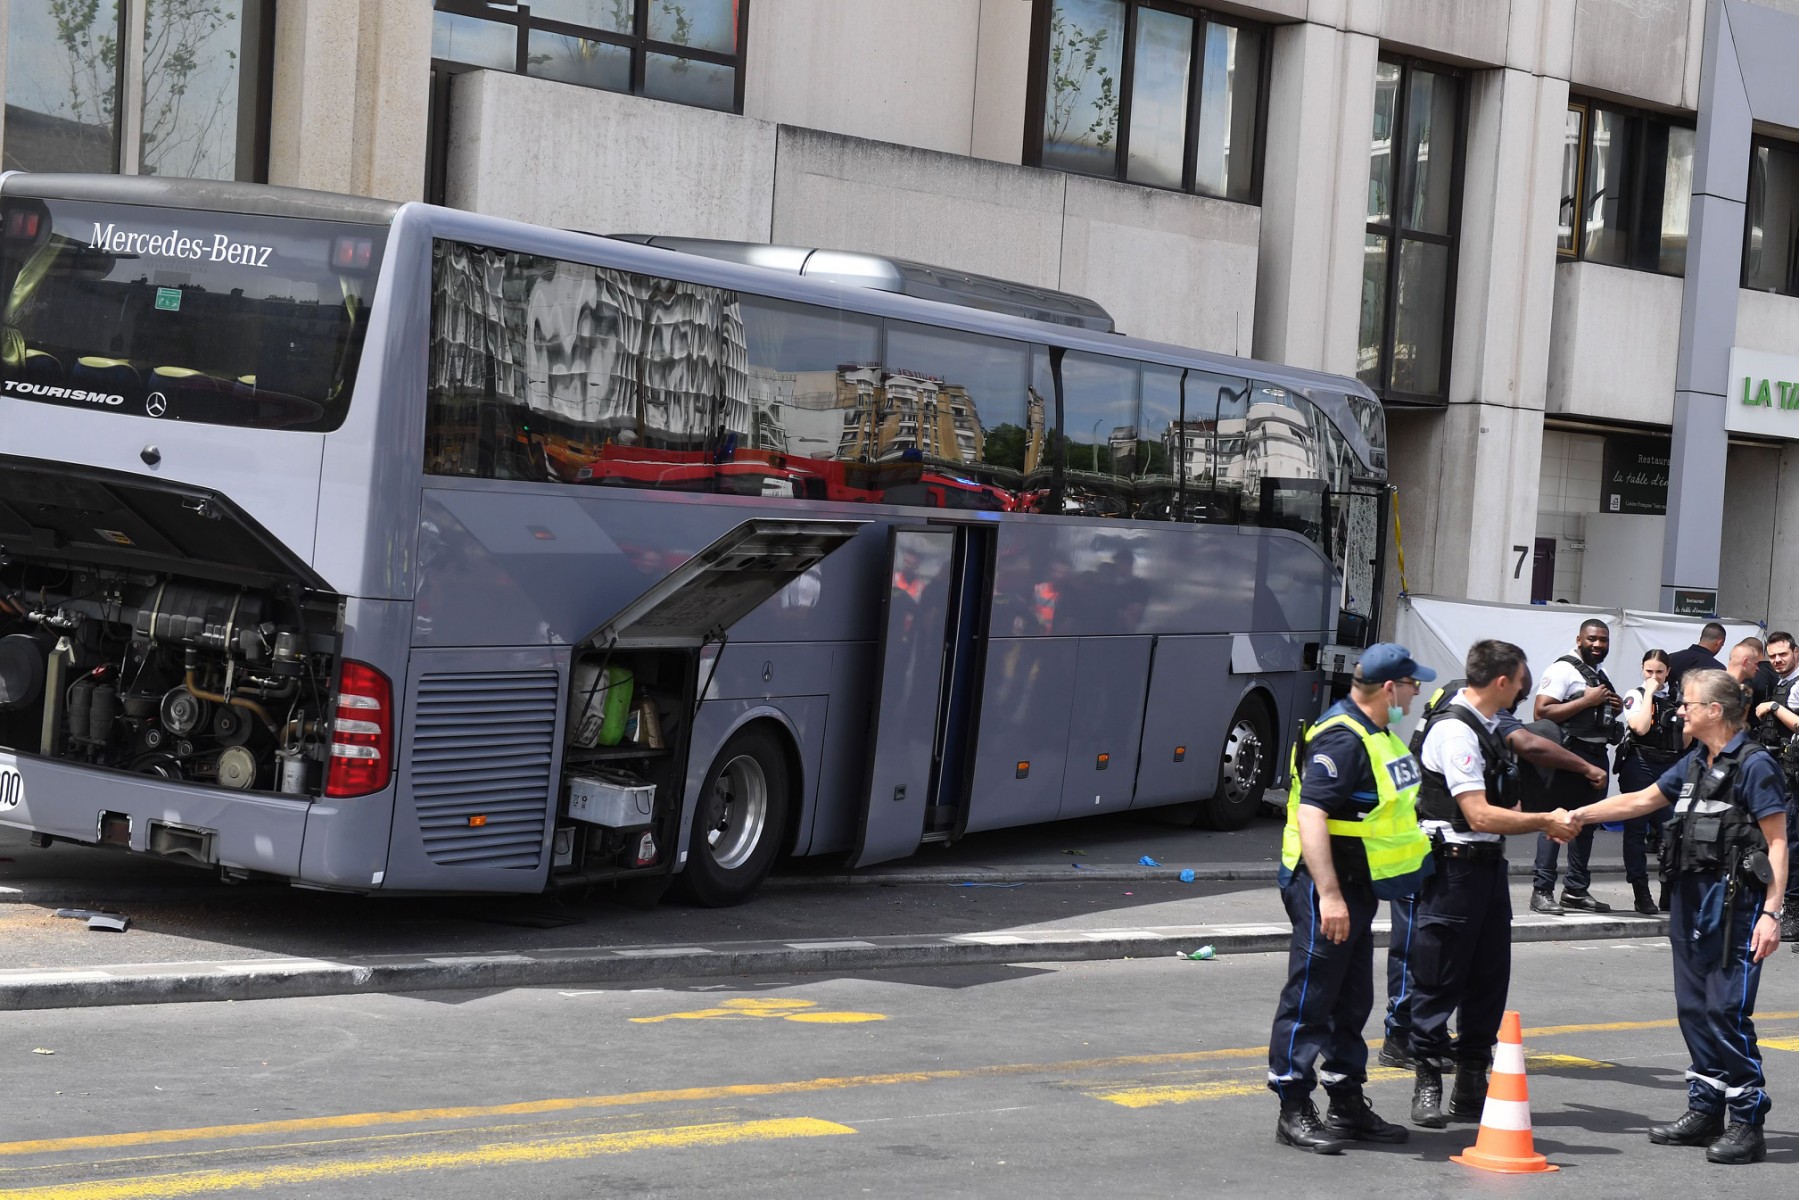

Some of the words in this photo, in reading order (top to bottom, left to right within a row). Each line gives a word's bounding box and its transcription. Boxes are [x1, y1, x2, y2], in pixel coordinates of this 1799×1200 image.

[88, 222, 272, 267] Mercedes-Benz
[4, 380, 124, 405] TOURISMO
[1743, 376, 1772, 407] LA
[1776, 380, 1799, 410] TA
[1637, 454, 1670, 466] Restaura
[1626, 472, 1649, 485] table
[1513, 545, 1529, 579] 7
[0, 770, 21, 806] 00
